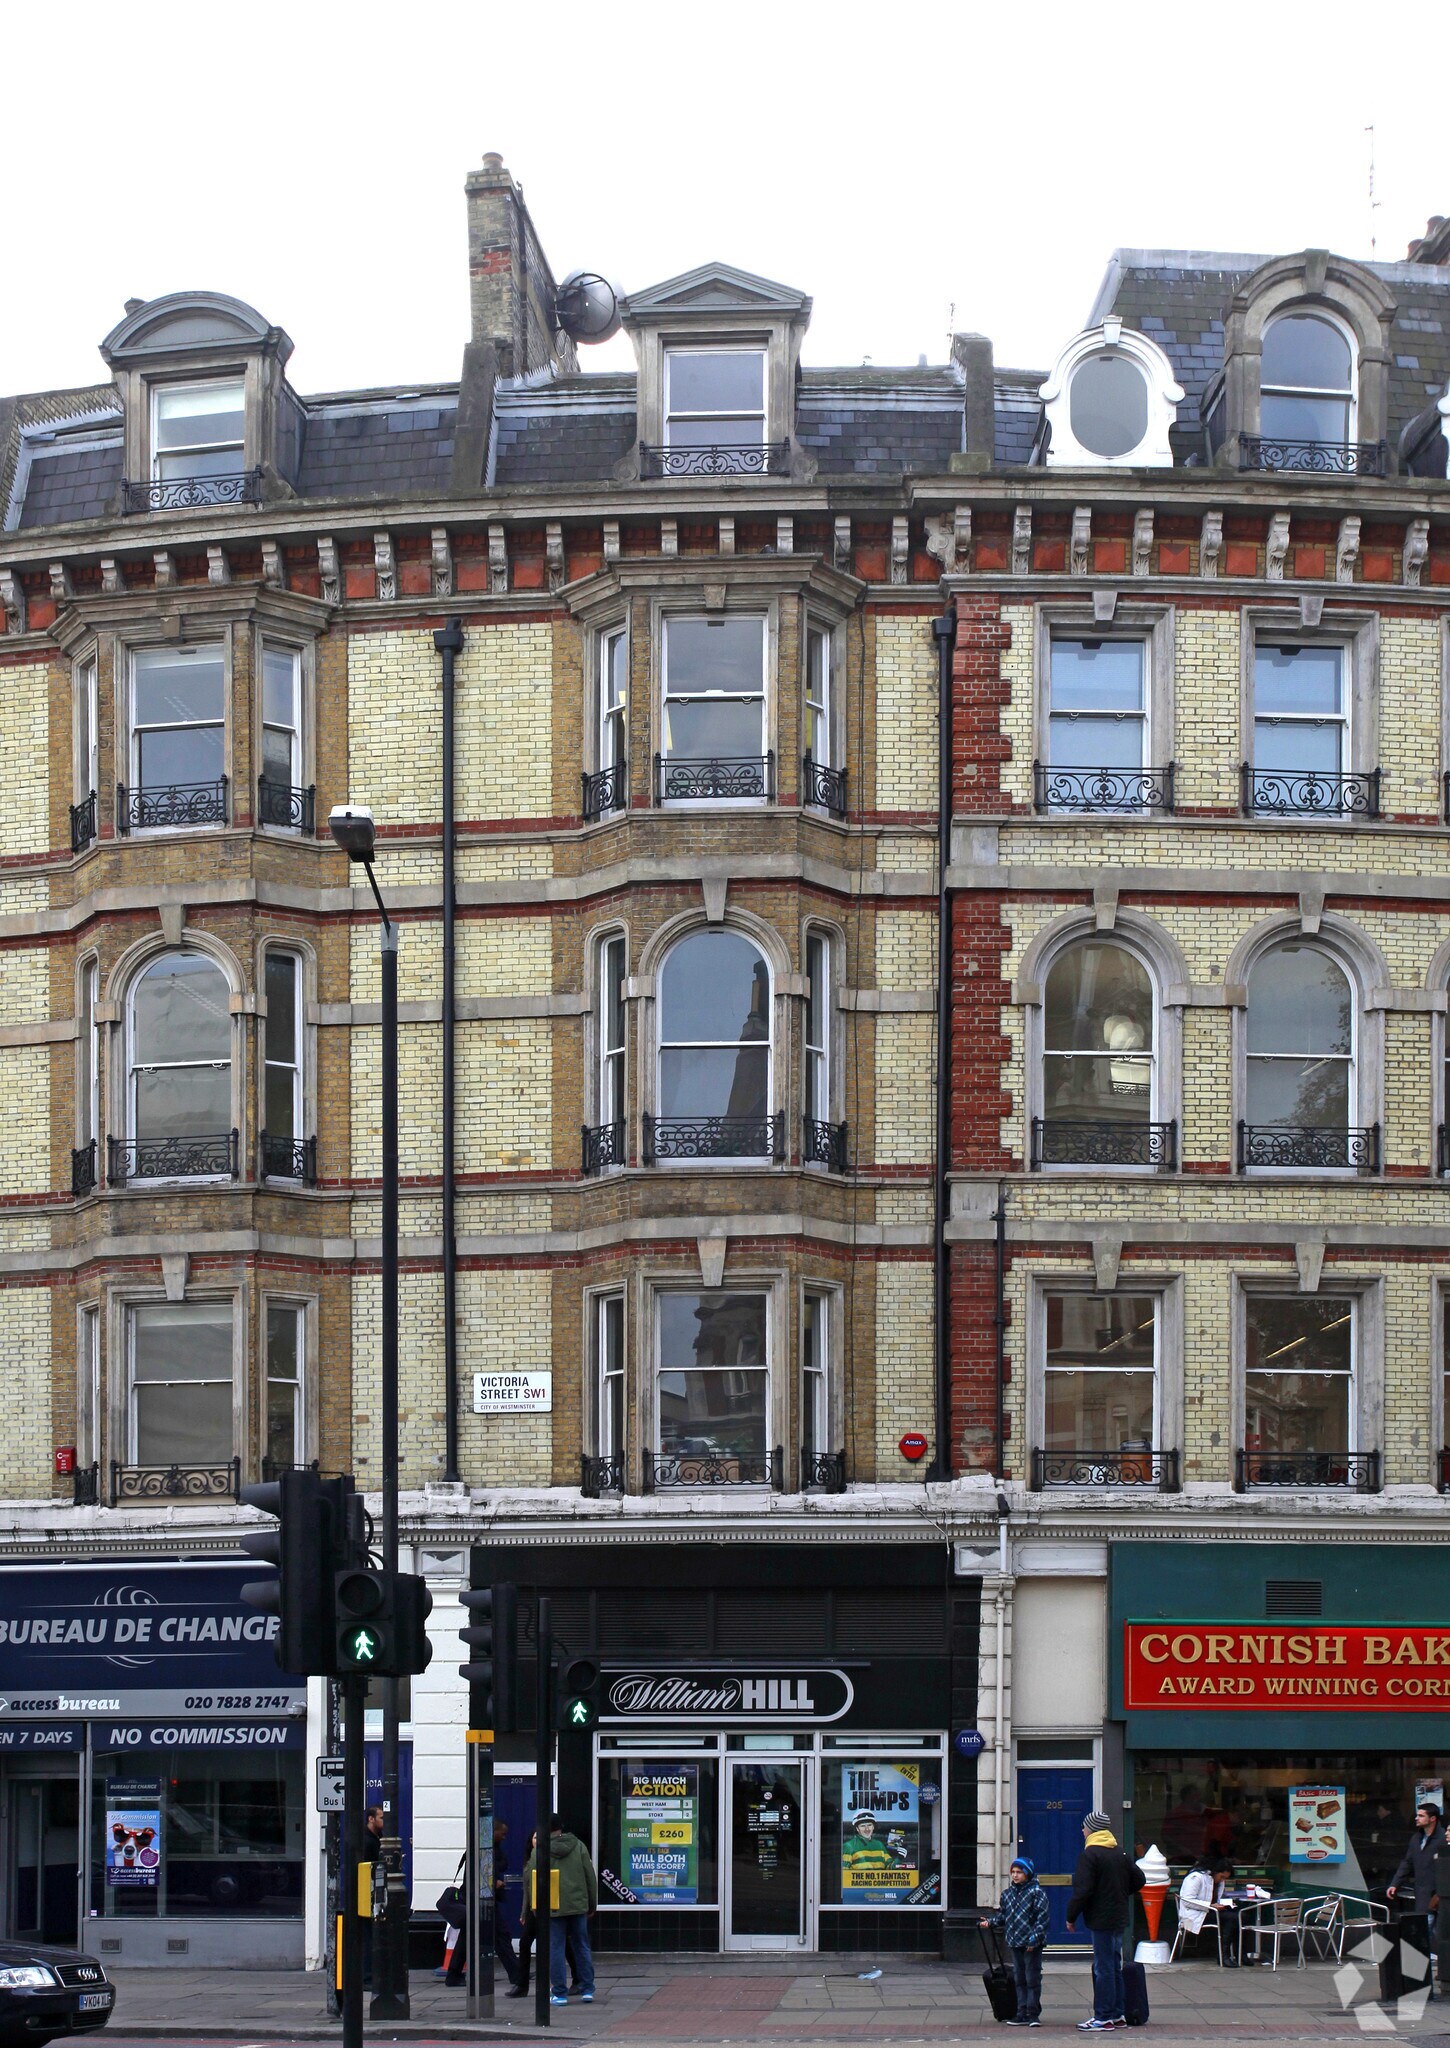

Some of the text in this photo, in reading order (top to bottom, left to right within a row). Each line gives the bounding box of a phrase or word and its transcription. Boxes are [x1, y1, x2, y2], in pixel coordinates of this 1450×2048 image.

[480, 1377, 529, 1387] VICTORIA
[480, 1388, 546, 1399] STREET SW1
[113, 1618, 153, 1643] DE
[158, 1616, 281, 1642] CHANGE
[1140, 1633, 1450, 1665] CORNISH BAK
[609, 1674, 815, 1711] William HILL
[1158, 1677, 1256, 1695] AWARD
[1263, 1677, 1379, 1696] WINNING
[10, 1695, 120, 1711] accessbureau
[185, 1695, 289, 1709] 020 7828 2747
[20, 1732, 29, 1744] 7
[33, 1731, 73, 1744] DAYS
[109, 1727, 287, 1745] NO COMMISSION
[847, 1771, 879, 1790] THE
[900, 1767, 916, 1781] ENTRY
[631, 1784, 687, 1796] ACTION
[323, 1797, 339, 1806] Bus
[847, 1791, 910, 1811] JUMPS
[1046, 1801, 1063, 1809] 205
[659, 1830, 684, 1838] £260
[631, 1854, 685, 1863] WILL BOTH
[851, 1872, 864, 1880] THE
[881, 1872, 911, 1880] FANTASY
[601, 1869, 637, 1903] £2 SLOTS
[909, 1889, 925, 1904] DEBIT
[923, 1874, 940, 1891] CARD
